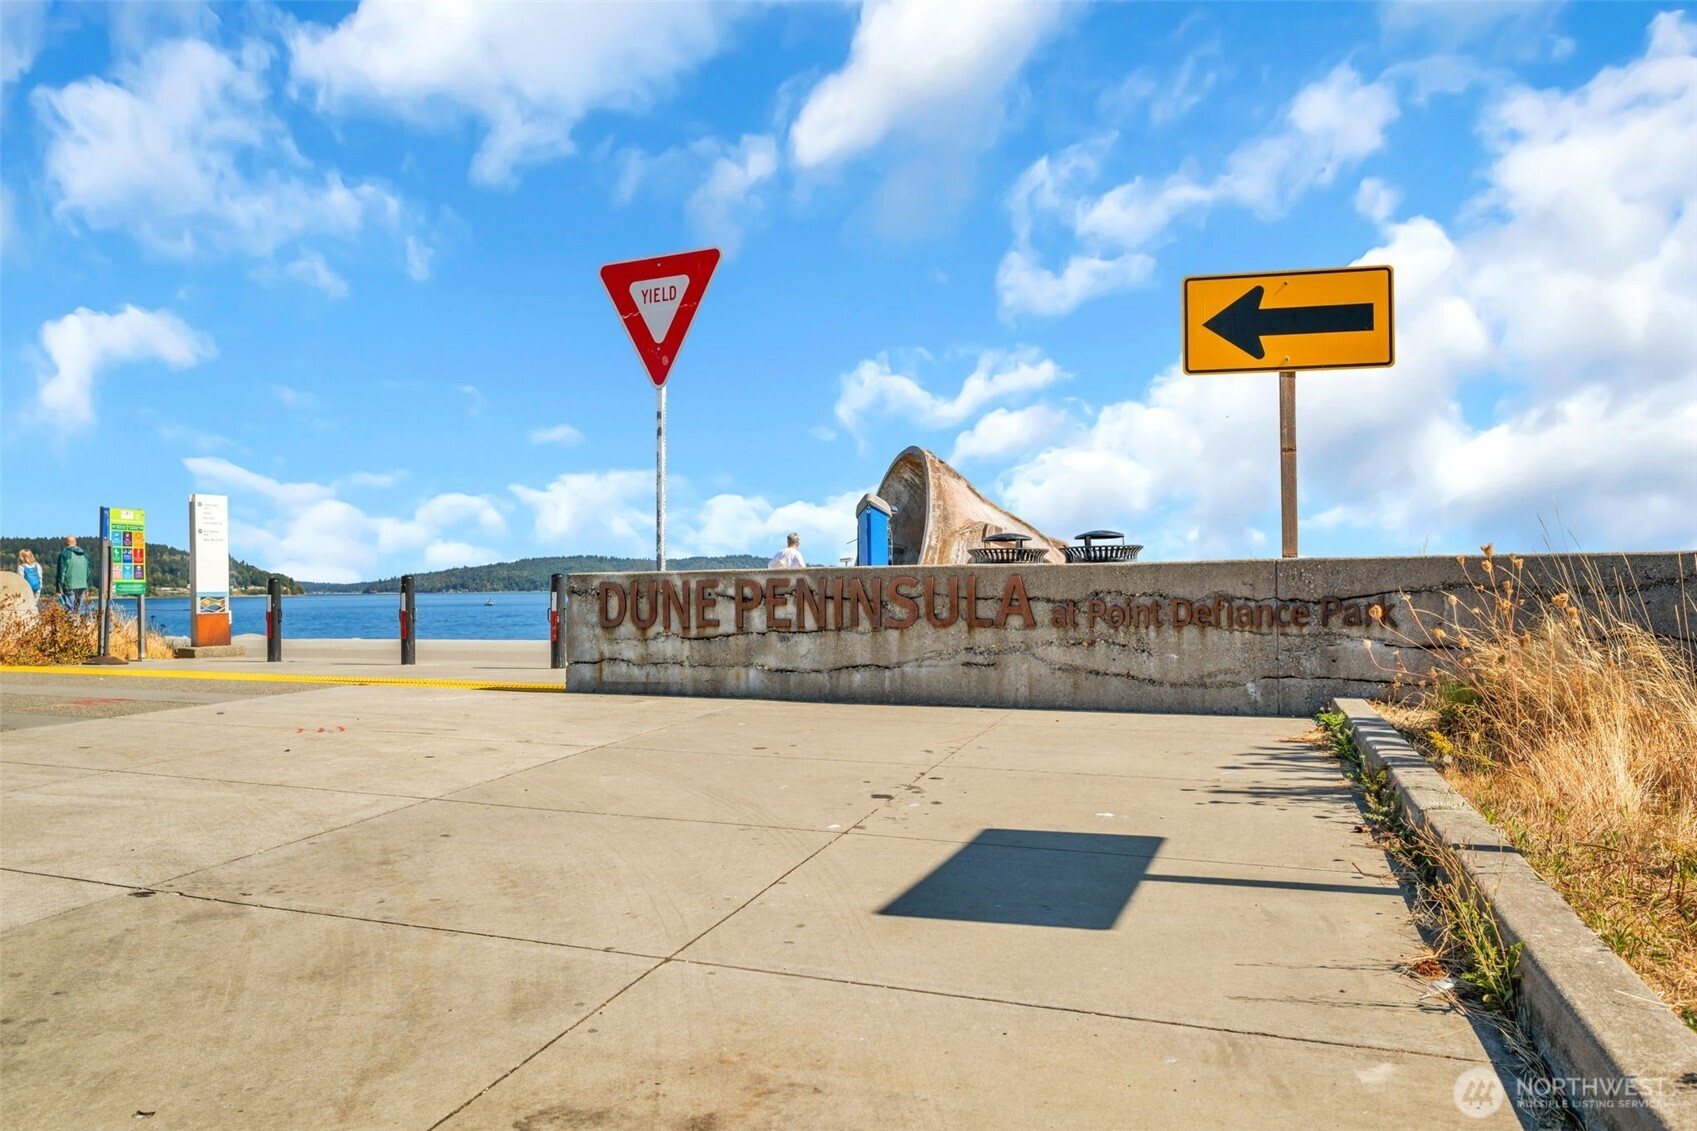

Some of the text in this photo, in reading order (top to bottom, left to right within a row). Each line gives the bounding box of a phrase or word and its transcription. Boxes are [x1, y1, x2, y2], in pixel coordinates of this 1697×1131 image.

[641, 286, 677, 304] YIELD
[598, 574, 1398, 629] DUNE PENINSULA at Point Defiance Park
